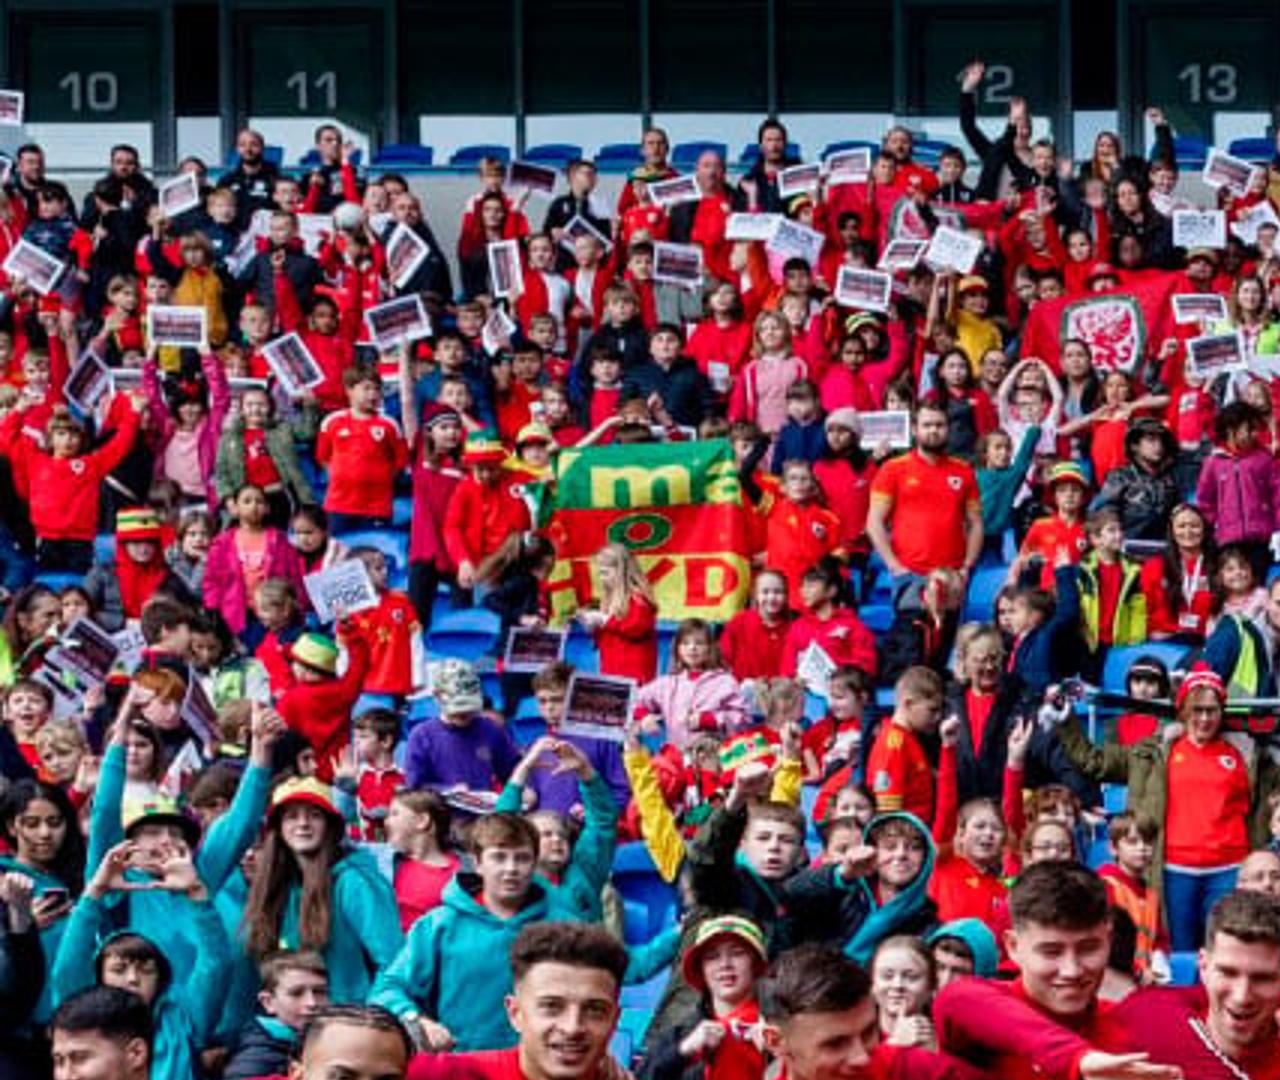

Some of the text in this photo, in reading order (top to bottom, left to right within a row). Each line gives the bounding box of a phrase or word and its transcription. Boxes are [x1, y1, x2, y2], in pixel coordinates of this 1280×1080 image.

[59, 71, 119, 112] 10
[287, 70, 338, 111] 11
[956, 64, 1014, 104] 2
[1178, 63, 1238, 104] 13
[606, 513, 673, 551] O
